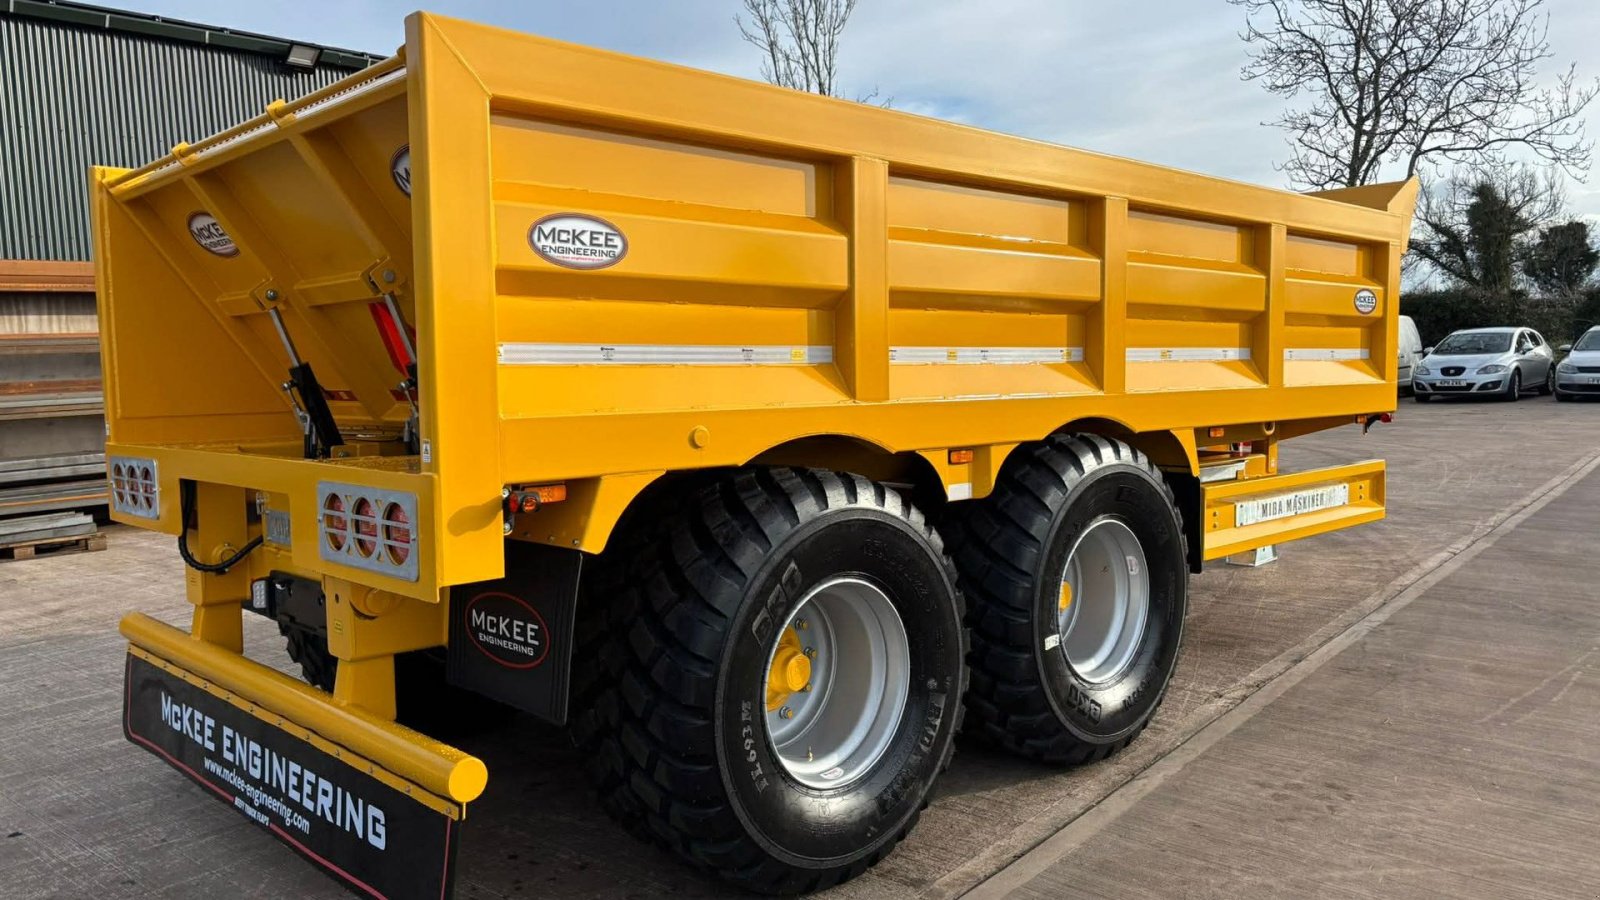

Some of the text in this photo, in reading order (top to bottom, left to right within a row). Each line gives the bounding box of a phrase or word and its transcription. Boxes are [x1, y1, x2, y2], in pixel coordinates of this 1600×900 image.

[541, 245, 617, 258] ENGINEERING
[479, 632, 535, 656] ENGINEERING
[204, 756, 310, 835] www.mckee-engineering.com
[223, 725, 387, 851] ENGINEERING
